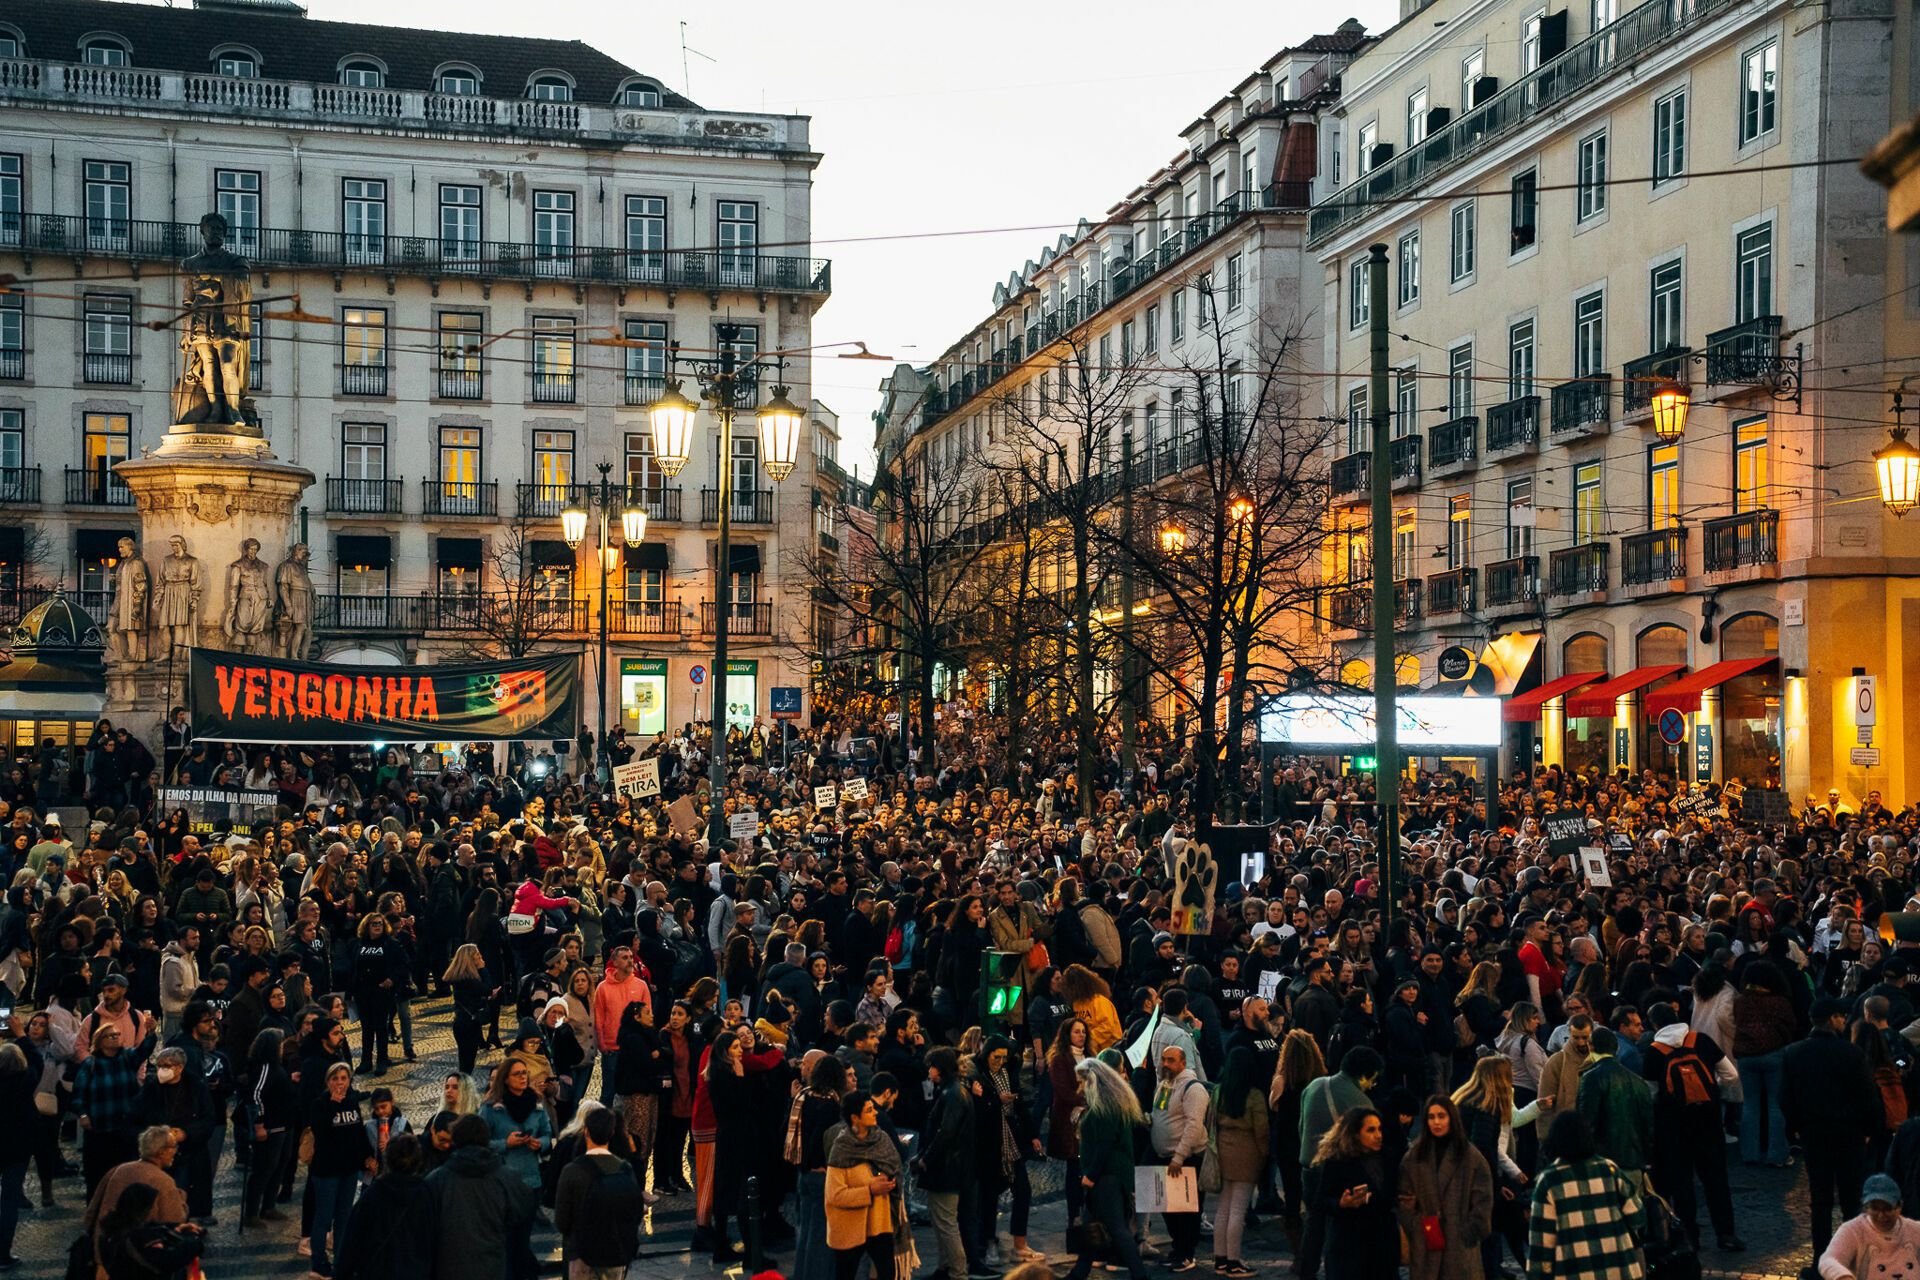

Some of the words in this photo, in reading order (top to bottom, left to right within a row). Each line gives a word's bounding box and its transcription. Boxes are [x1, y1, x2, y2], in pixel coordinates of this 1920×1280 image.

[215, 666, 440, 724] VERGONHA
[632, 779, 657, 793] IRA
[192, 790, 204, 801] DA
[205, 791, 225, 803] ILHA
[226, 791, 238, 804] DA
[239, 793, 278, 806] MADEIRA
[342, 1110, 360, 1123] IRA
